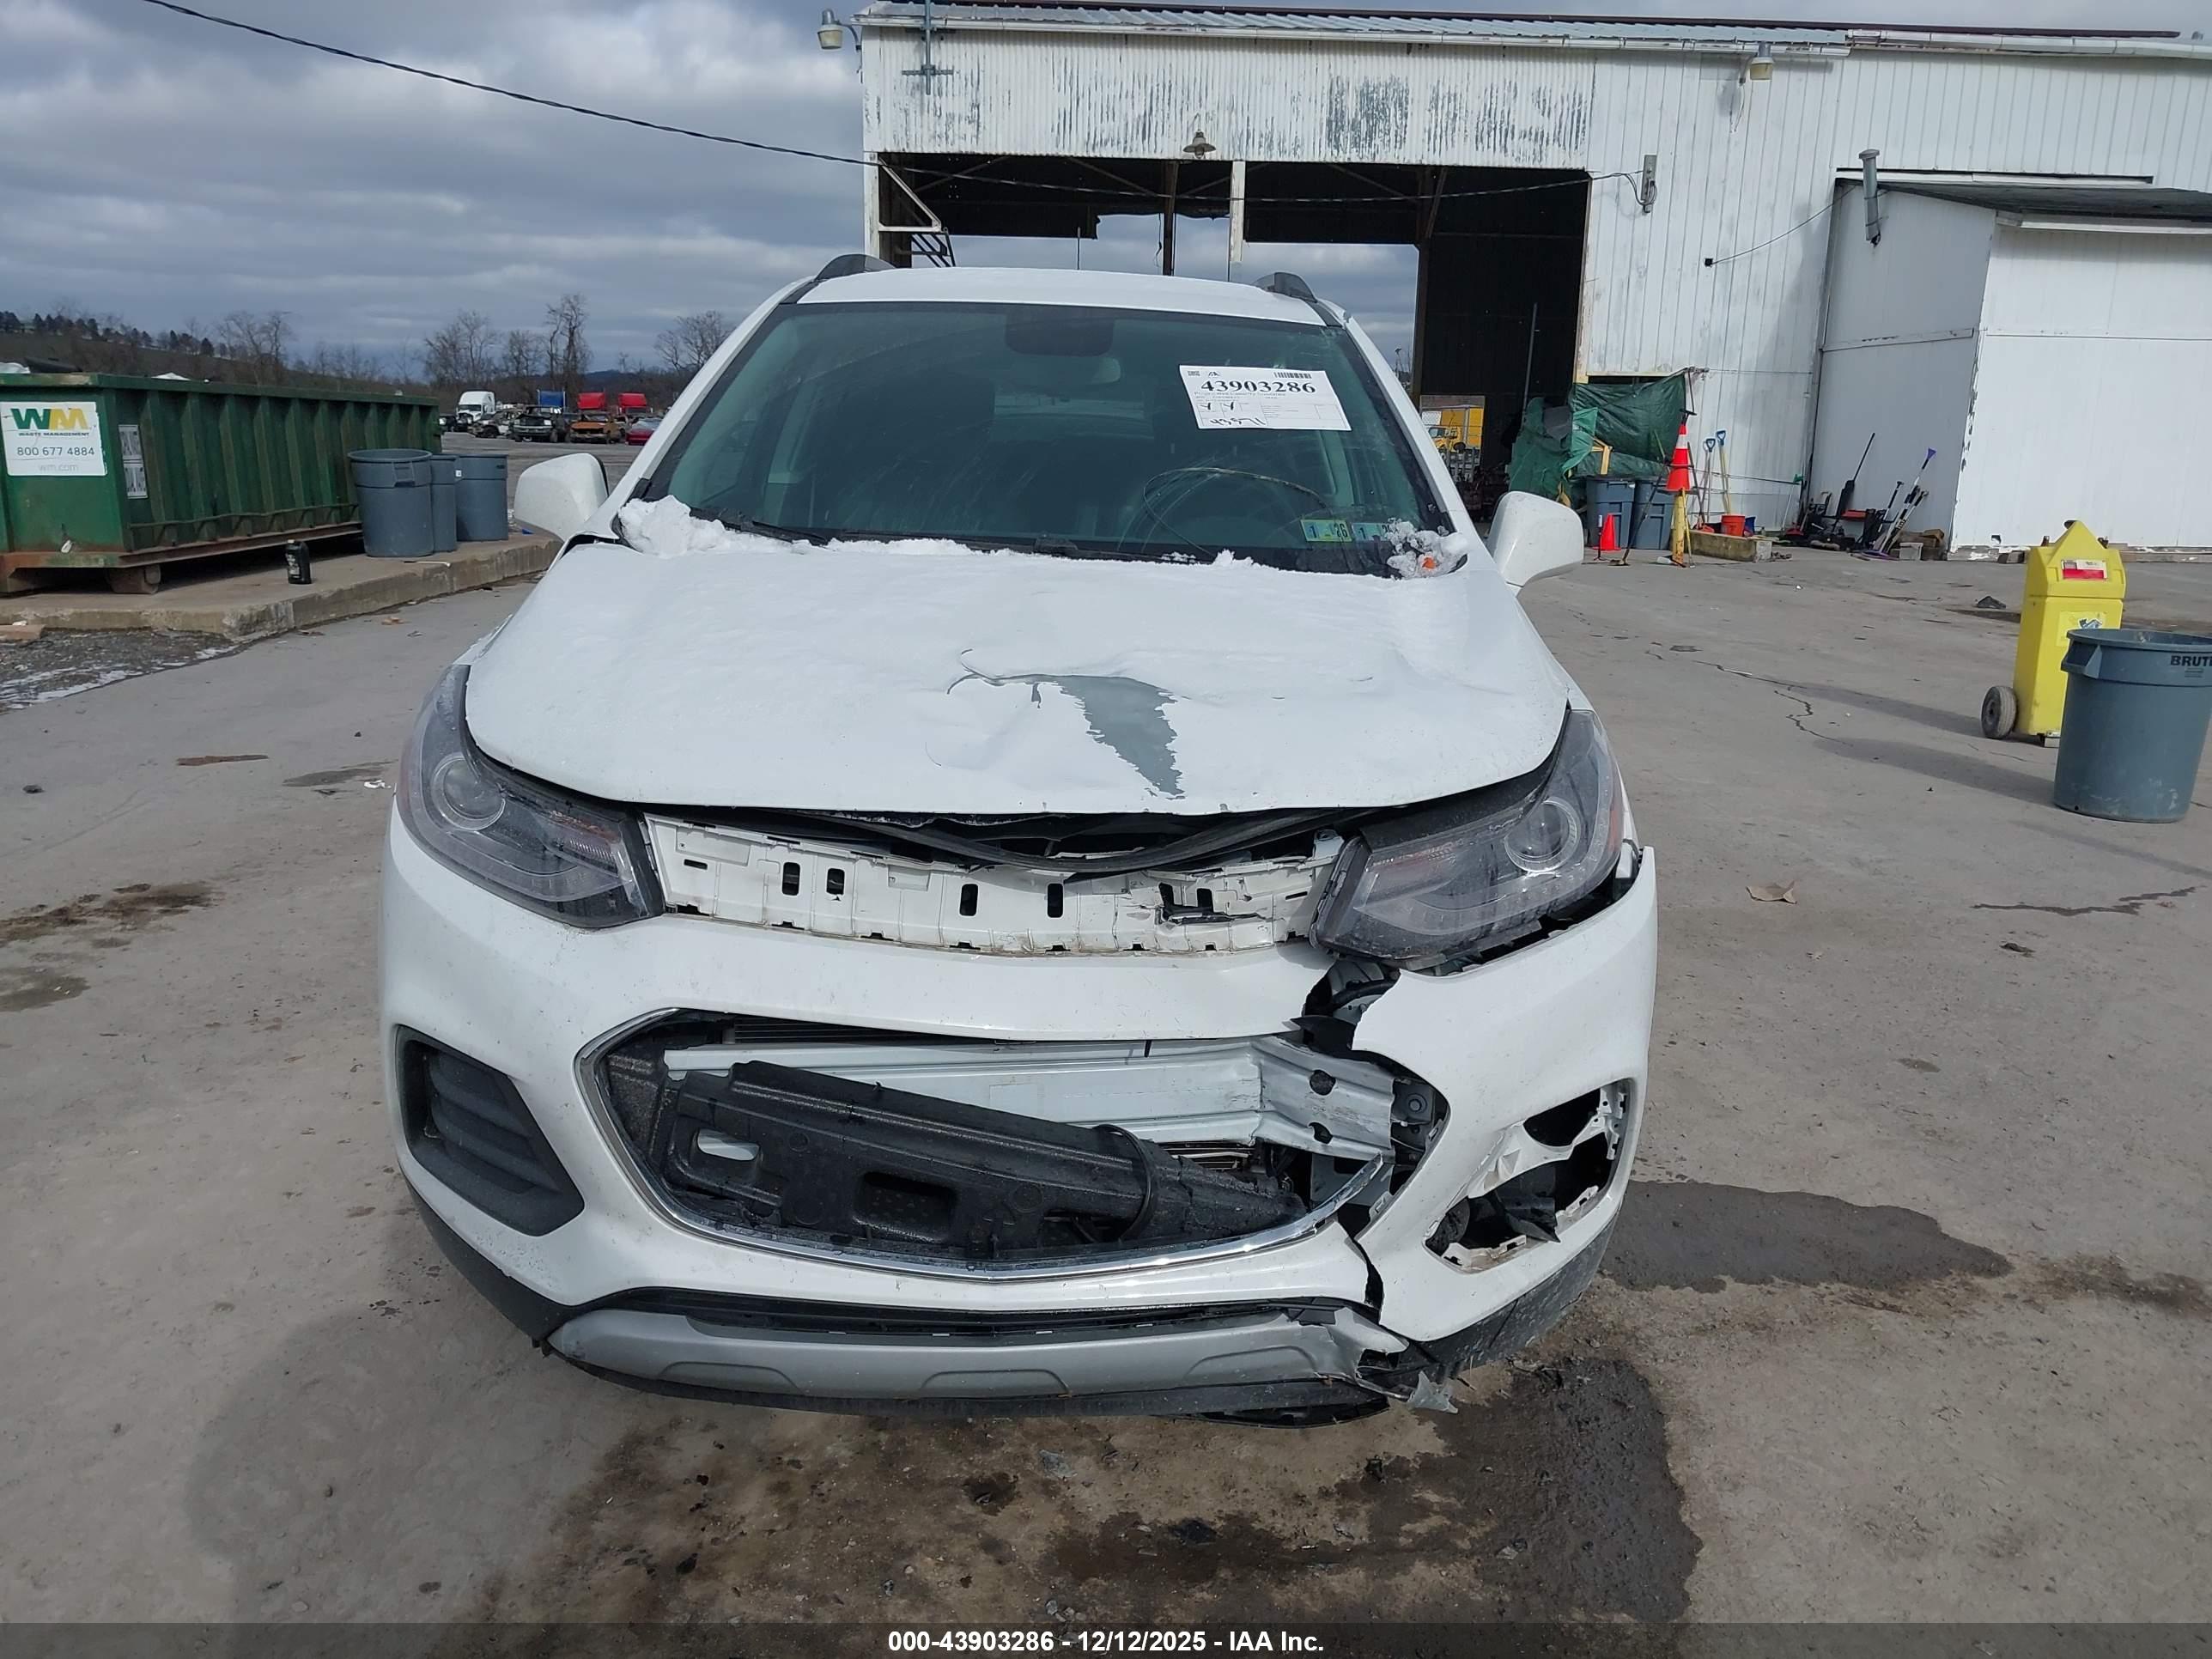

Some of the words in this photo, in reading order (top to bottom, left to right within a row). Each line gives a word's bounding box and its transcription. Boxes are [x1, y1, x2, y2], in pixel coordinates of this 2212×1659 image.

[1200, 380, 1316, 393] 43903286
[10, 408, 88, 429] WM
[17, 447, 40, 456] 800
[42, 447, 64, 456] 677
[67, 447, 95, 456] 4884
